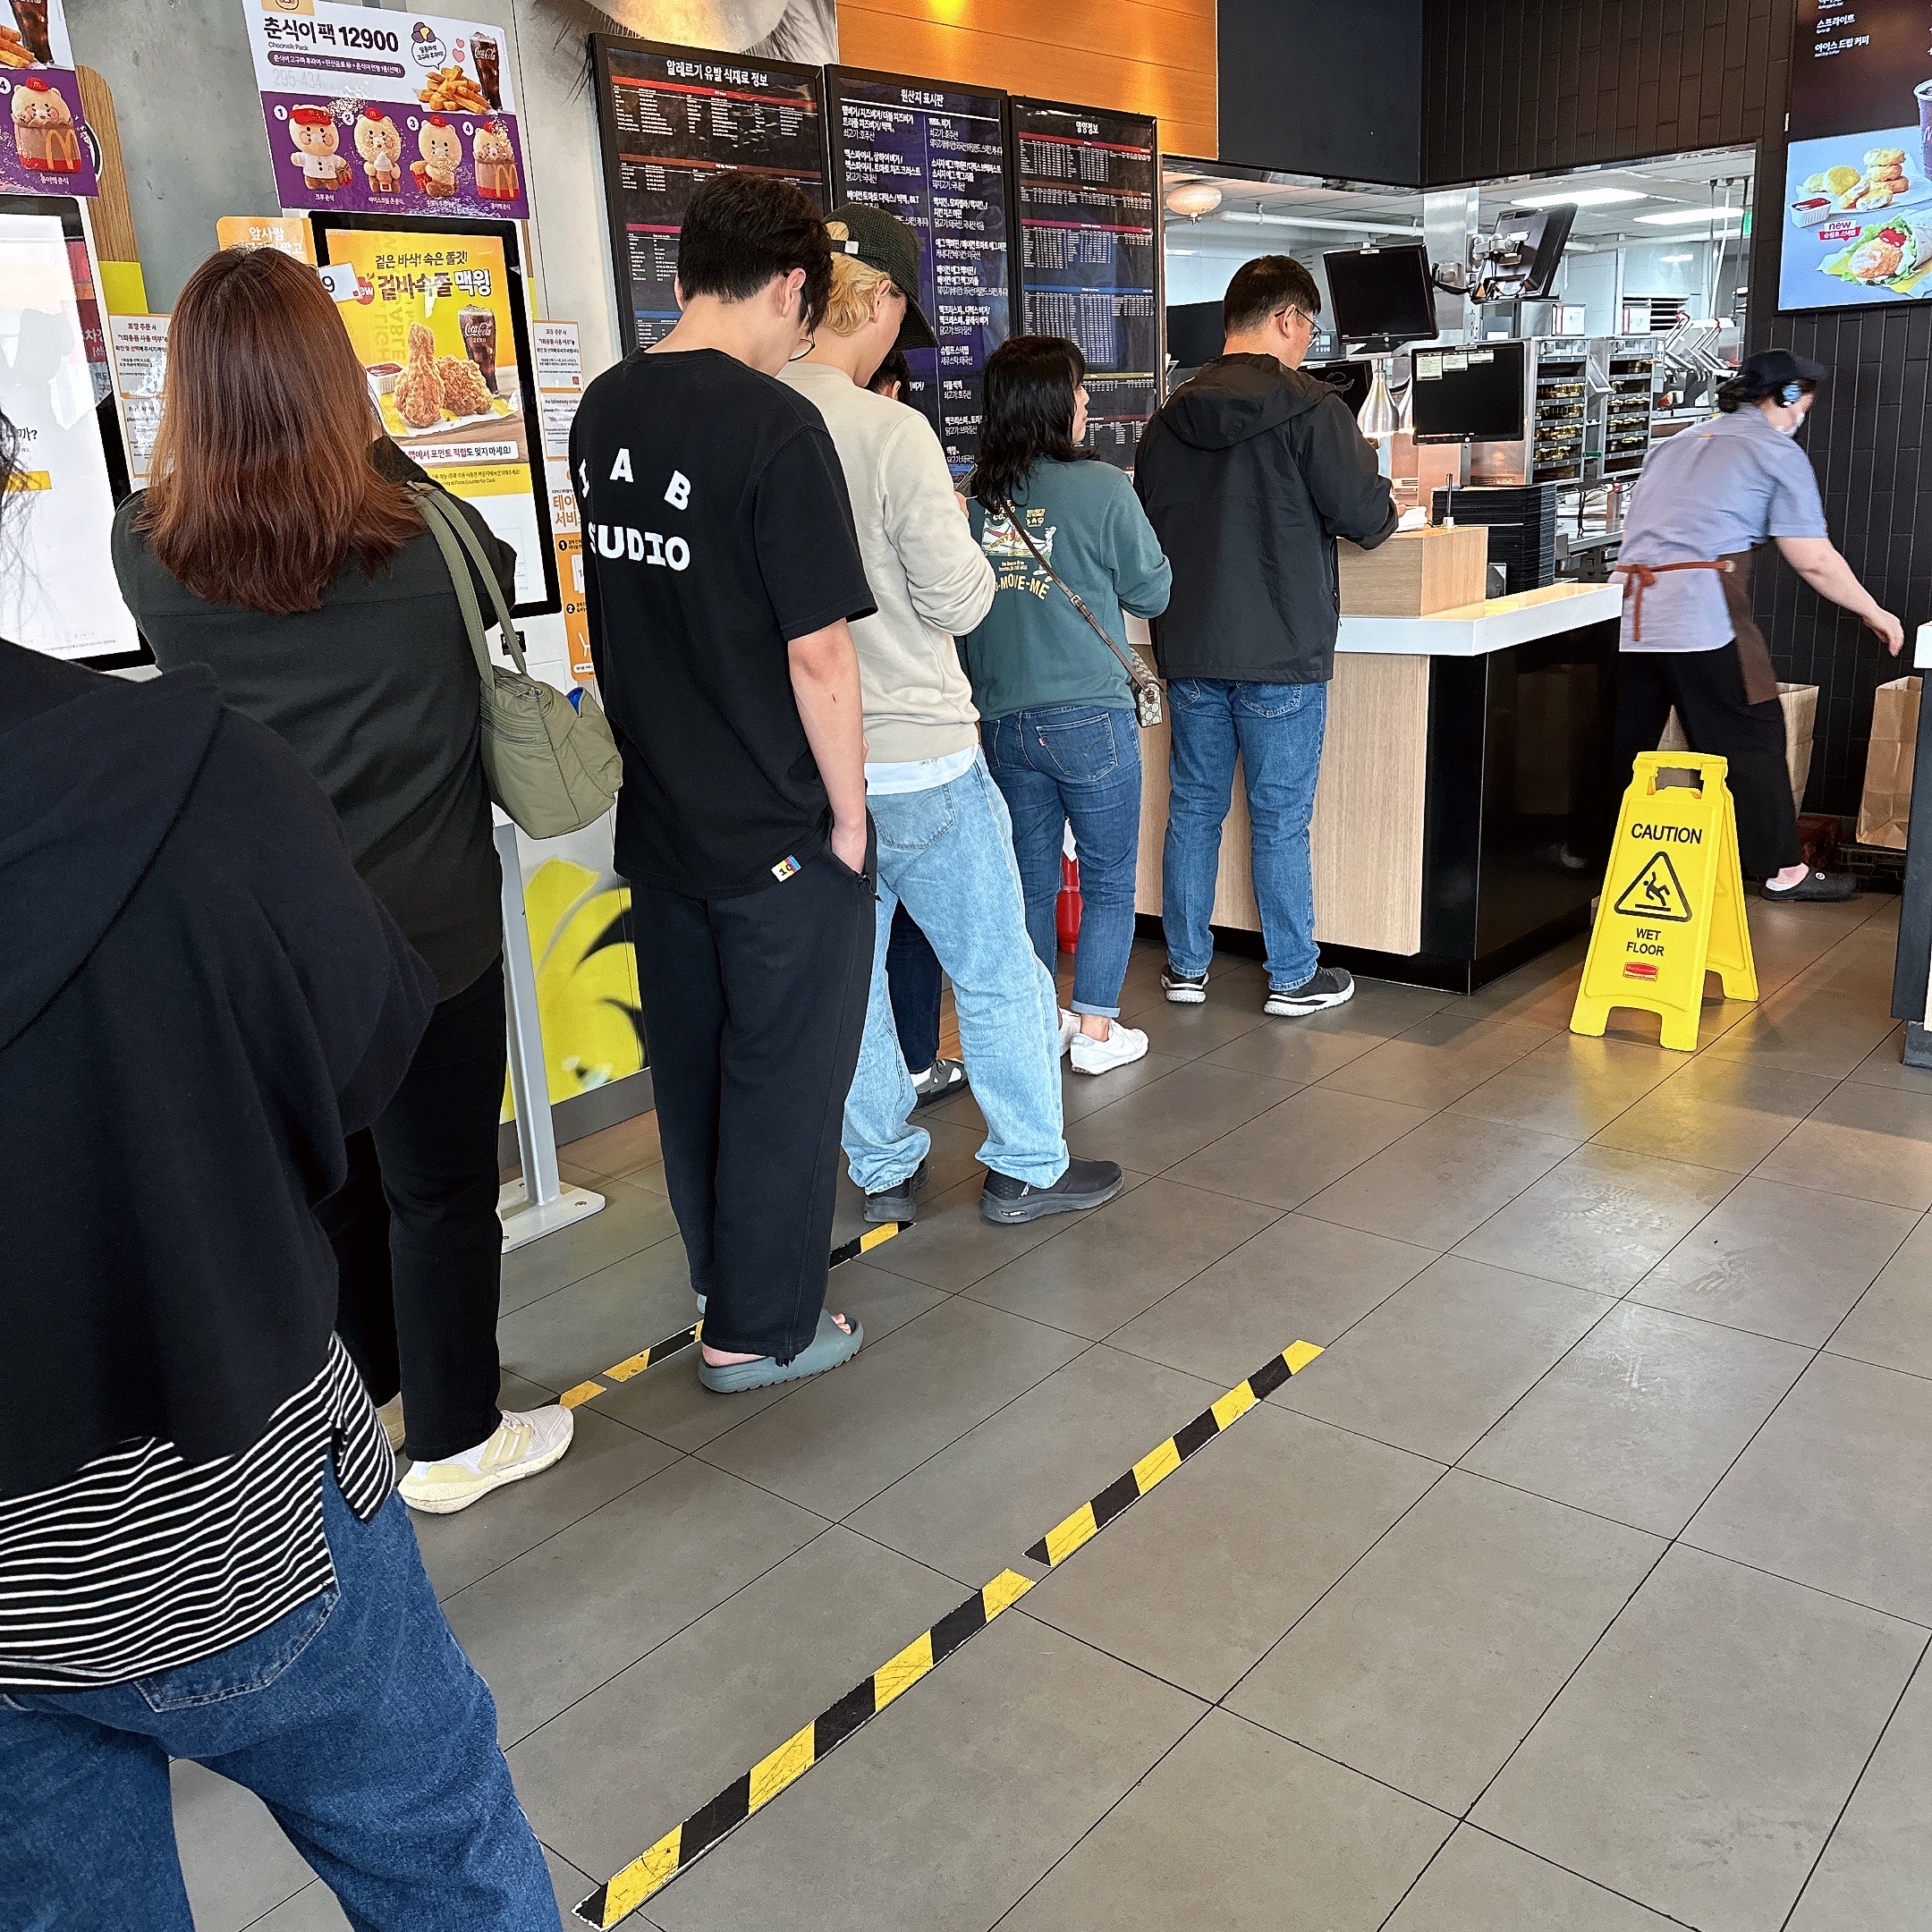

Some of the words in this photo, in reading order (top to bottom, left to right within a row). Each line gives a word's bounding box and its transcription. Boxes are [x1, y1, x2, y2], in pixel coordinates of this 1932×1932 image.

[1817, 13, 1856, 29] 스프라이트
[264, 16, 317, 44] 춘식이
[317, 22, 336, 46] 팩
[338, 26, 399, 53] 12900
[1814, 40, 1838, 52] 아이스
[1854, 34, 1870, 47] 커피
[666, 59, 704, 80] 알레르기
[704, 65, 722, 82] 유발
[723, 68, 750, 85] 식재료
[751, 72, 769, 87] 정보
[901, 89, 922, 105] 원산지
[922, 92, 945, 107] 표시판
[1075, 120, 1099, 135] 영양정보
[249, 226, 285, 241] 앞사람
[1828, 221, 1852, 231] new
[375, 254, 396, 269] 겉은
[397, 252, 422, 267] 바삭!
[422, 251, 445, 267] 속은
[445, 250, 468, 266] 쫄깃!
[377, 271, 453, 301] 겉바속쫄
[453, 268, 492, 297] 맥윙
[140, 323, 151, 331] 주문
[408, 449, 430, 461] 앱에서
[430, 448, 453, 459] 포인트
[453, 447, 474, 458] 적립도
[474, 446, 488, 457] 잊지
[488, 445, 512, 456] 마세요!
[553, 493, 576, 512] 테이
[555, 511, 581, 528] 서비
[1631, 823, 1703, 844] CAUTION
[779, 863, 793, 877] 10
[1636, 927, 1662, 941] WET
[1626, 941, 1665, 956] FLOOR
